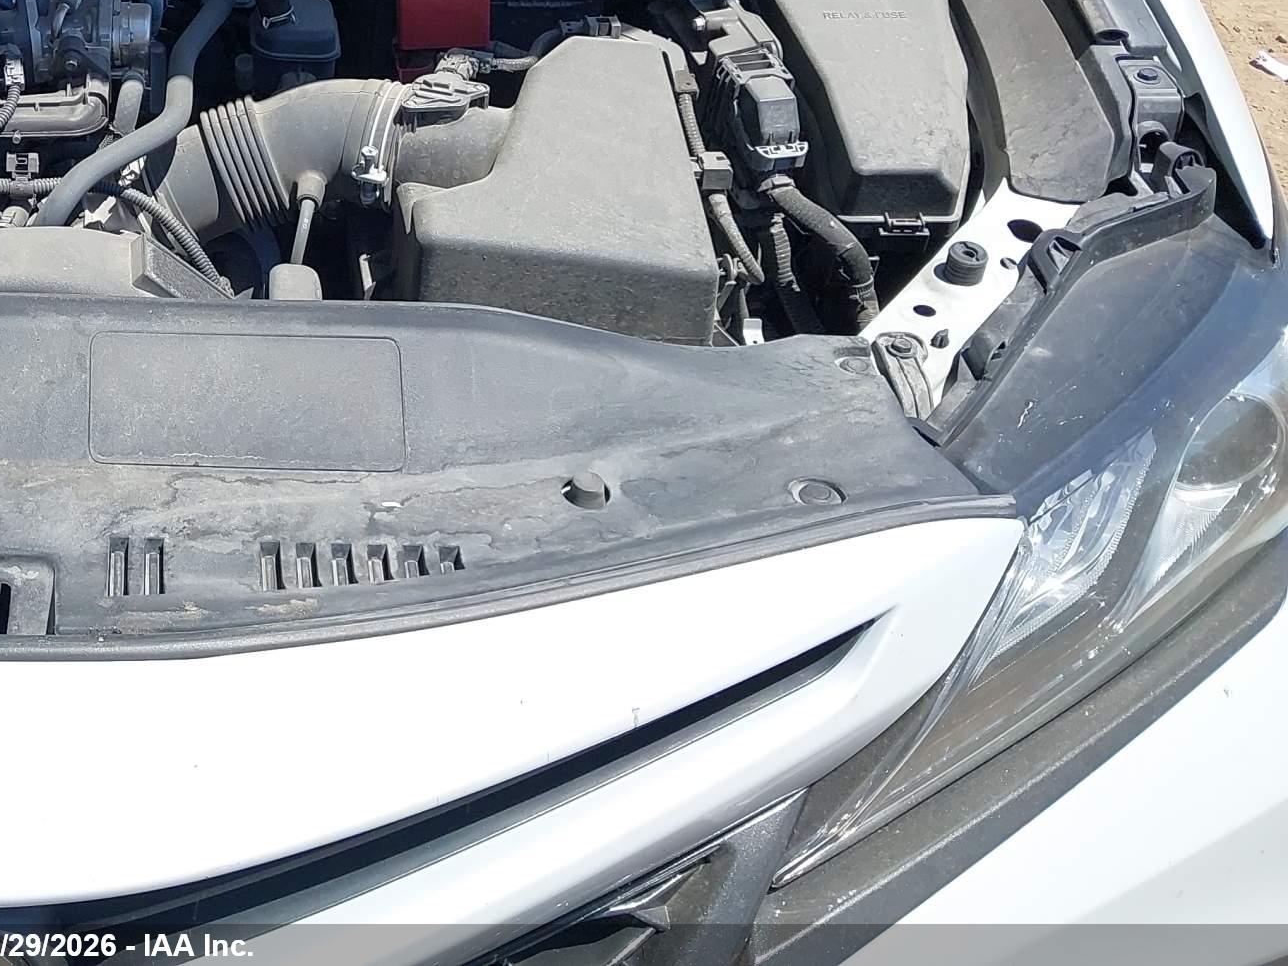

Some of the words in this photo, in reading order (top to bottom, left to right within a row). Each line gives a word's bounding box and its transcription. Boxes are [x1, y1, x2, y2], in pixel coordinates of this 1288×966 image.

[822, 11, 860, 20] RELAY
[864, 11, 872, 20] &
[875, 11, 907, 20] FUSE
